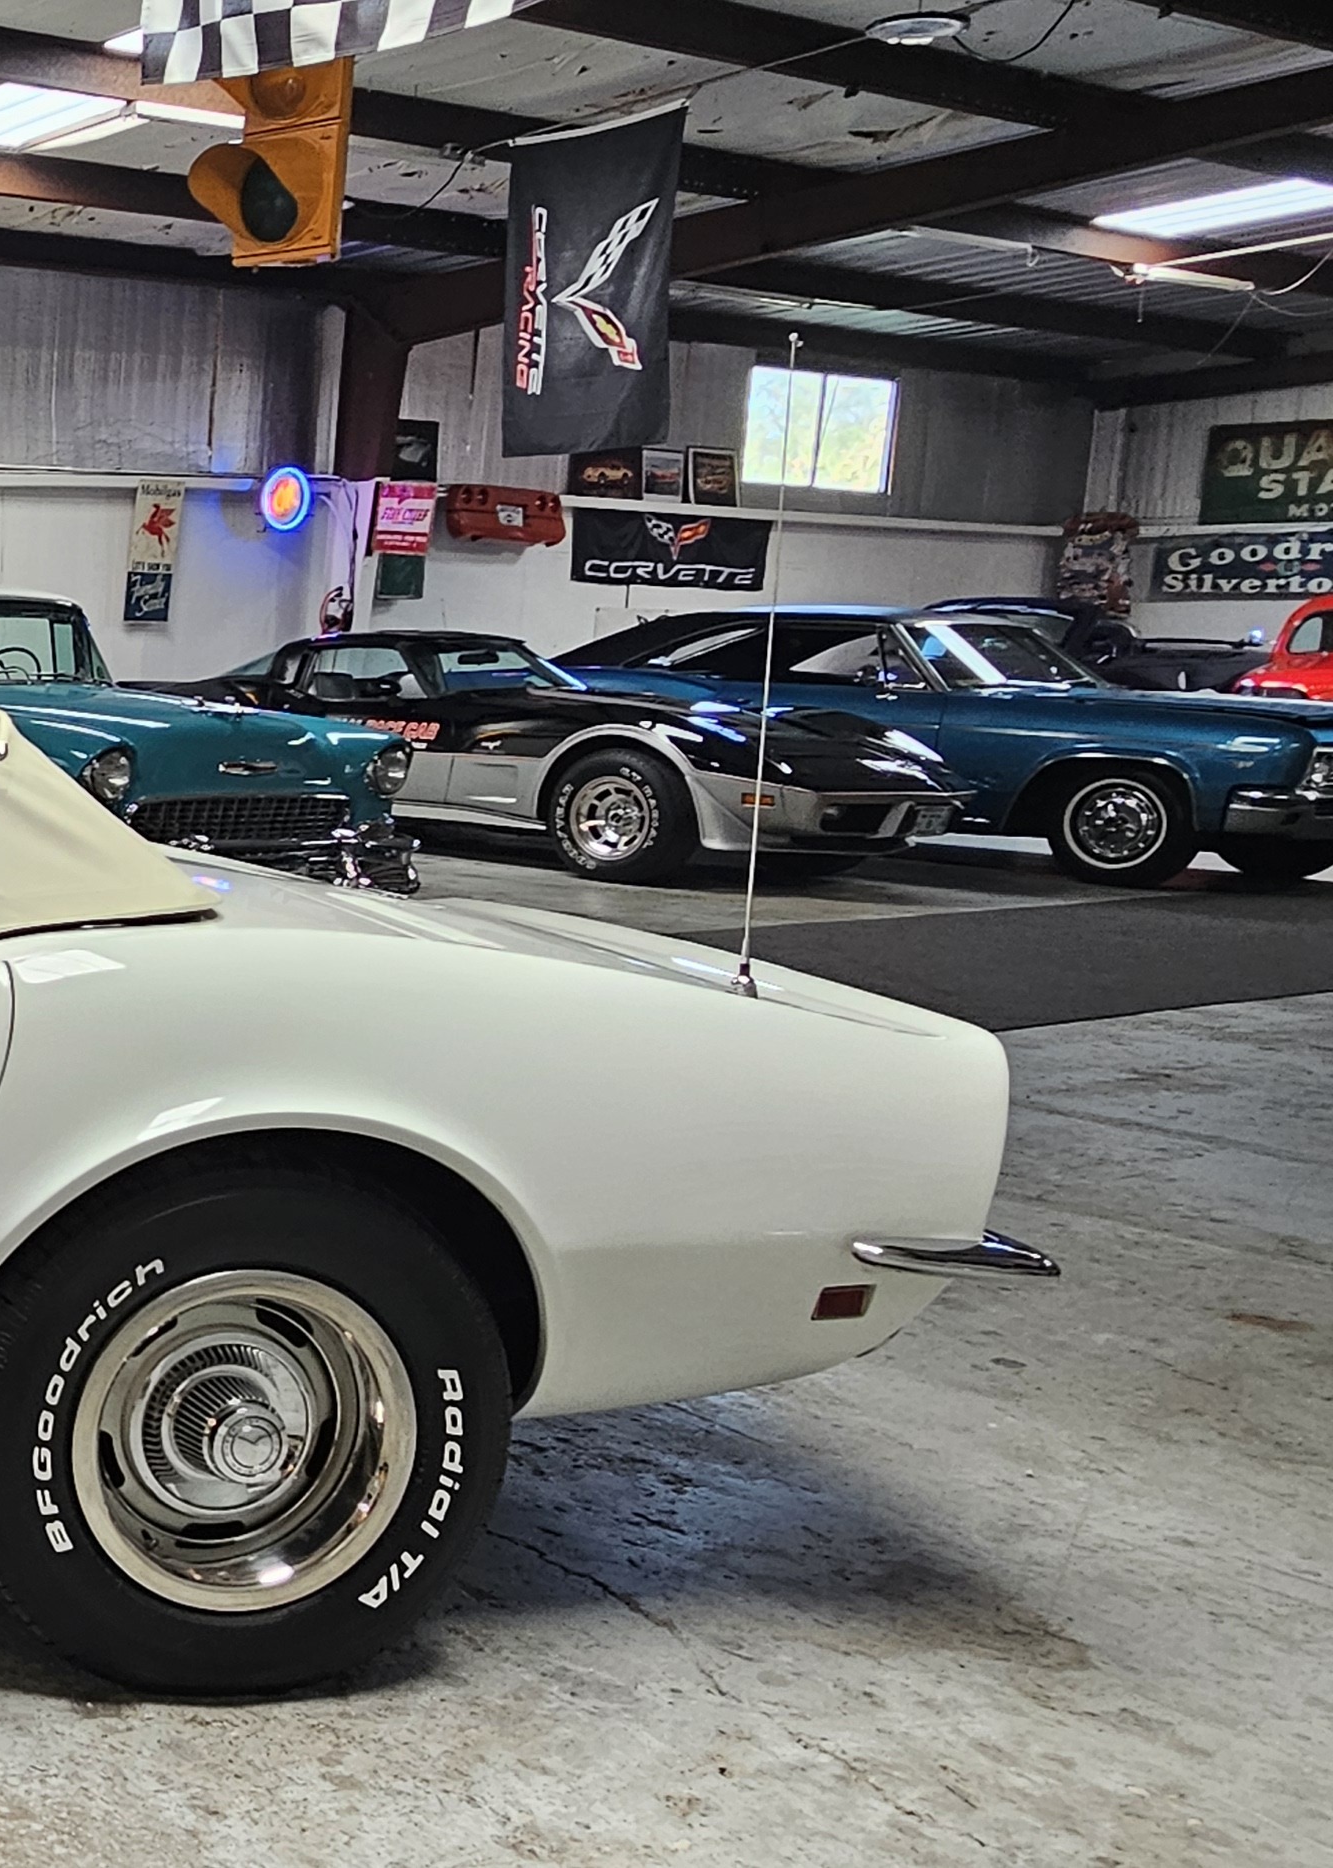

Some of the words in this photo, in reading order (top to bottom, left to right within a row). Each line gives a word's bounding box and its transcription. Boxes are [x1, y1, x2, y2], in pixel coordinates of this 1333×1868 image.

[527, 206, 548, 396] CORVETTE
[584, 559, 756, 585] CORVETTE
[32, 1256, 166, 1554] BFGoodrich
[420, 1368, 465, 1539] Radial
[357, 1551, 425, 1609] T/A
